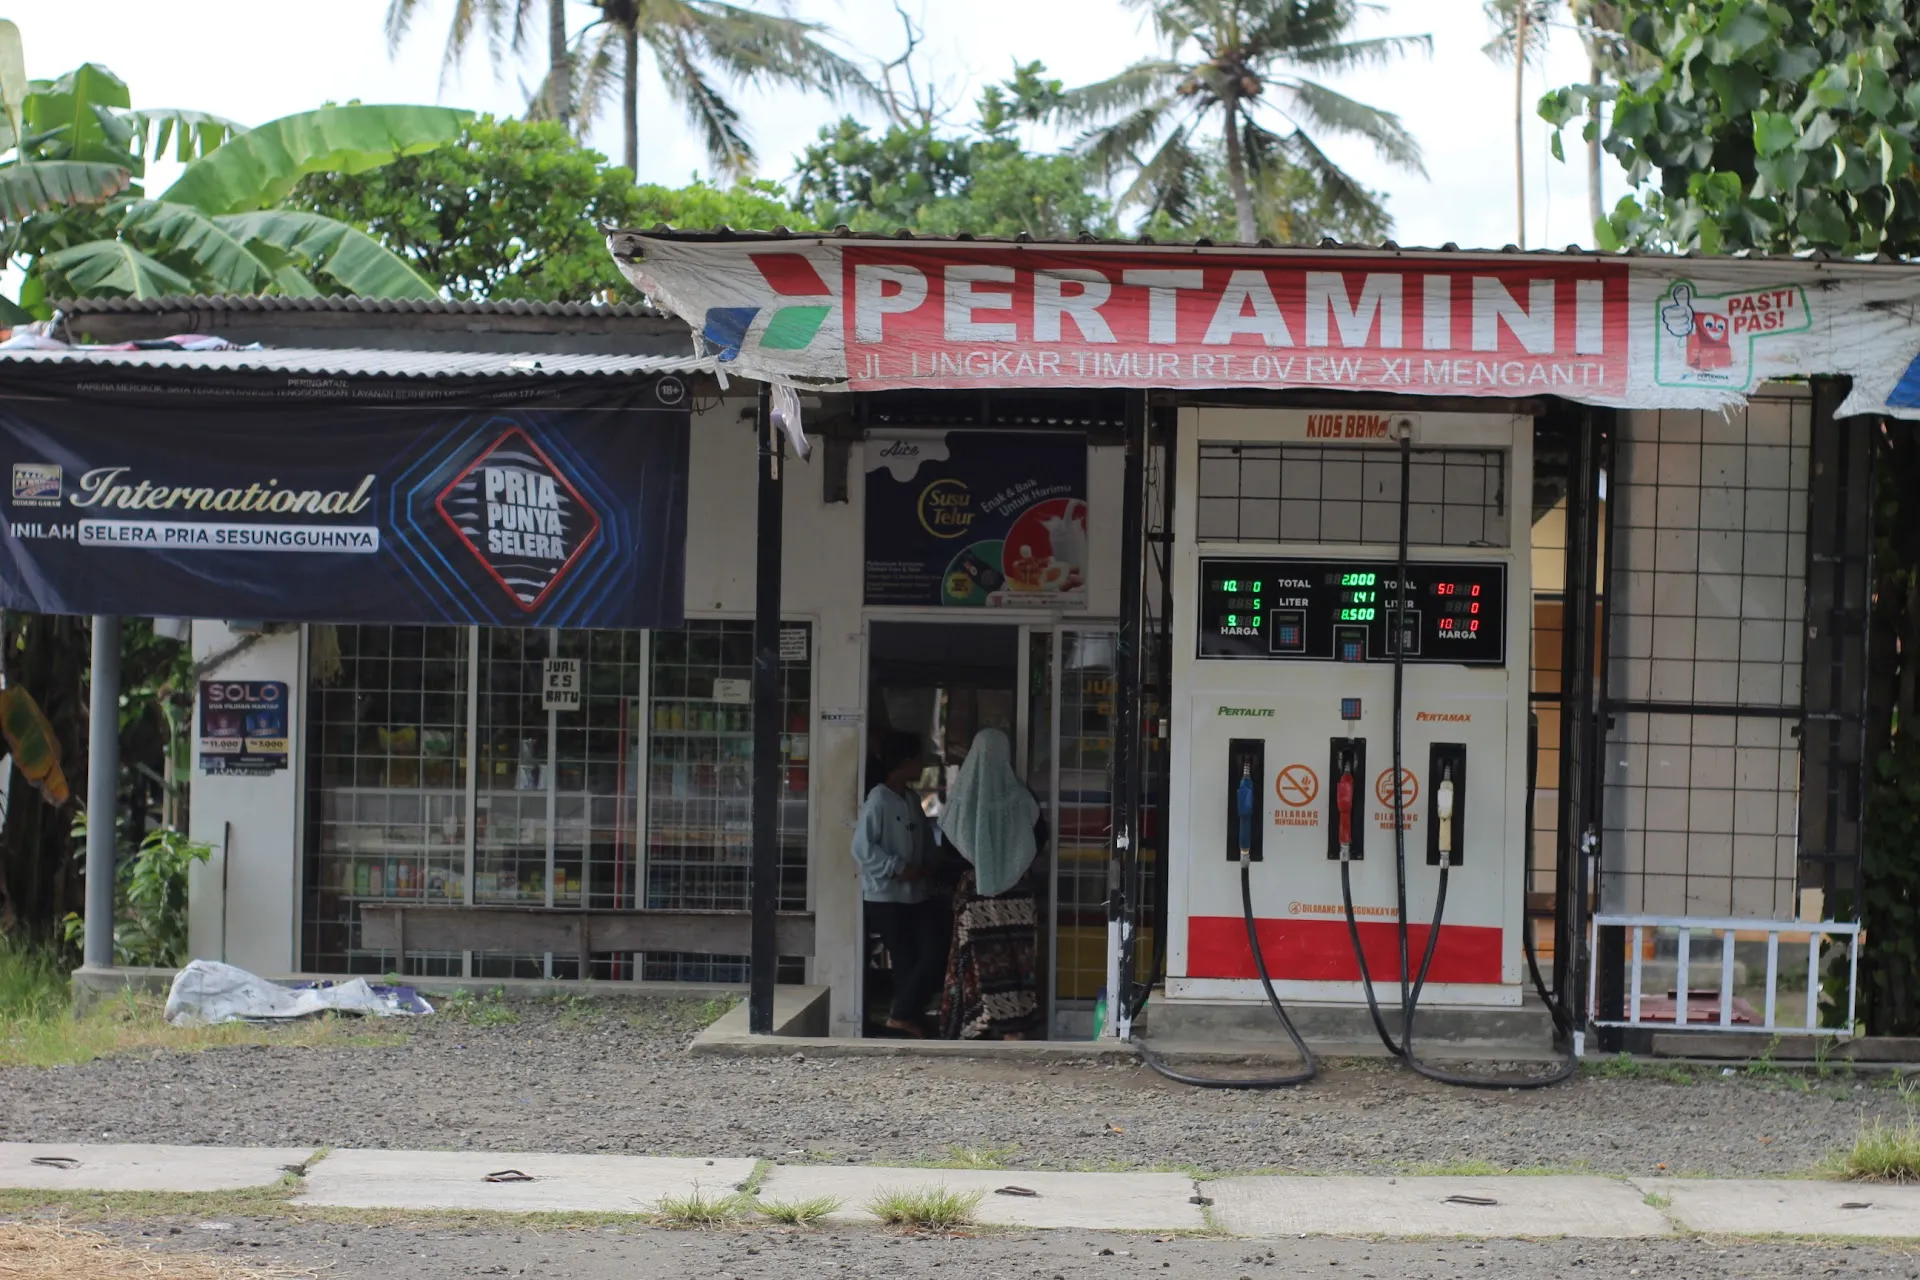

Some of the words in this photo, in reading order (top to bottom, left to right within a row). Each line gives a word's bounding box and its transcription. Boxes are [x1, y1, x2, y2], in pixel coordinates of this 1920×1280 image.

[855, 264, 1604, 356] PERTAMINI
[1728, 290, 1793, 316] PASTI
[1734, 311, 1784, 334] PAS!
[912, 351, 1061, 378] LINGKAR
[1071, 352, 1181, 380] TIMUR
[1306, 356, 1367, 383] RW.
[1380, 357, 1411, 385] XI
[1423, 358, 1604, 387] MENGANTI
[661, 384, 680, 395] 18+
[1307, 415, 1343, 438] KIOS
[1345, 415, 1379, 438] BBM
[880, 440, 920, 457] Aice
[69, 466, 376, 514] International
[485, 467, 557, 510] PRIA
[929, 489, 971, 506] Susu
[980, 492, 1007, 513] Enak
[998, 493, 1032, 516] Untuk
[487, 503, 563, 536] PUNYA
[933, 507, 976, 525] Telur
[10, 522, 76, 540] INILAH
[84, 526, 157, 542] SELERA
[165, 529, 209, 544] PRIA
[216, 530, 372, 547] SESUNGGUHNYA
[488, 529, 567, 560] SELERA
[1278, 579, 1311, 588] TOTAL
[1383, 580, 1417, 590] TOAL
[1279, 598, 1309, 607] LITER
[1220, 627, 1259, 636] HARGA
[1438, 630, 1477, 640] HARGA
[545, 660, 576, 672] JUAL
[550, 674, 572, 687] ES
[208, 684, 280, 702] SOLO
[546, 690, 579, 703] BATU
[1217, 706, 1275, 717] PERTALITE
[1416, 711, 1472, 722] PERTAMAX
[1275, 810, 1318, 819] DILARANG
[1303, 905, 1336, 913] DILARANG
